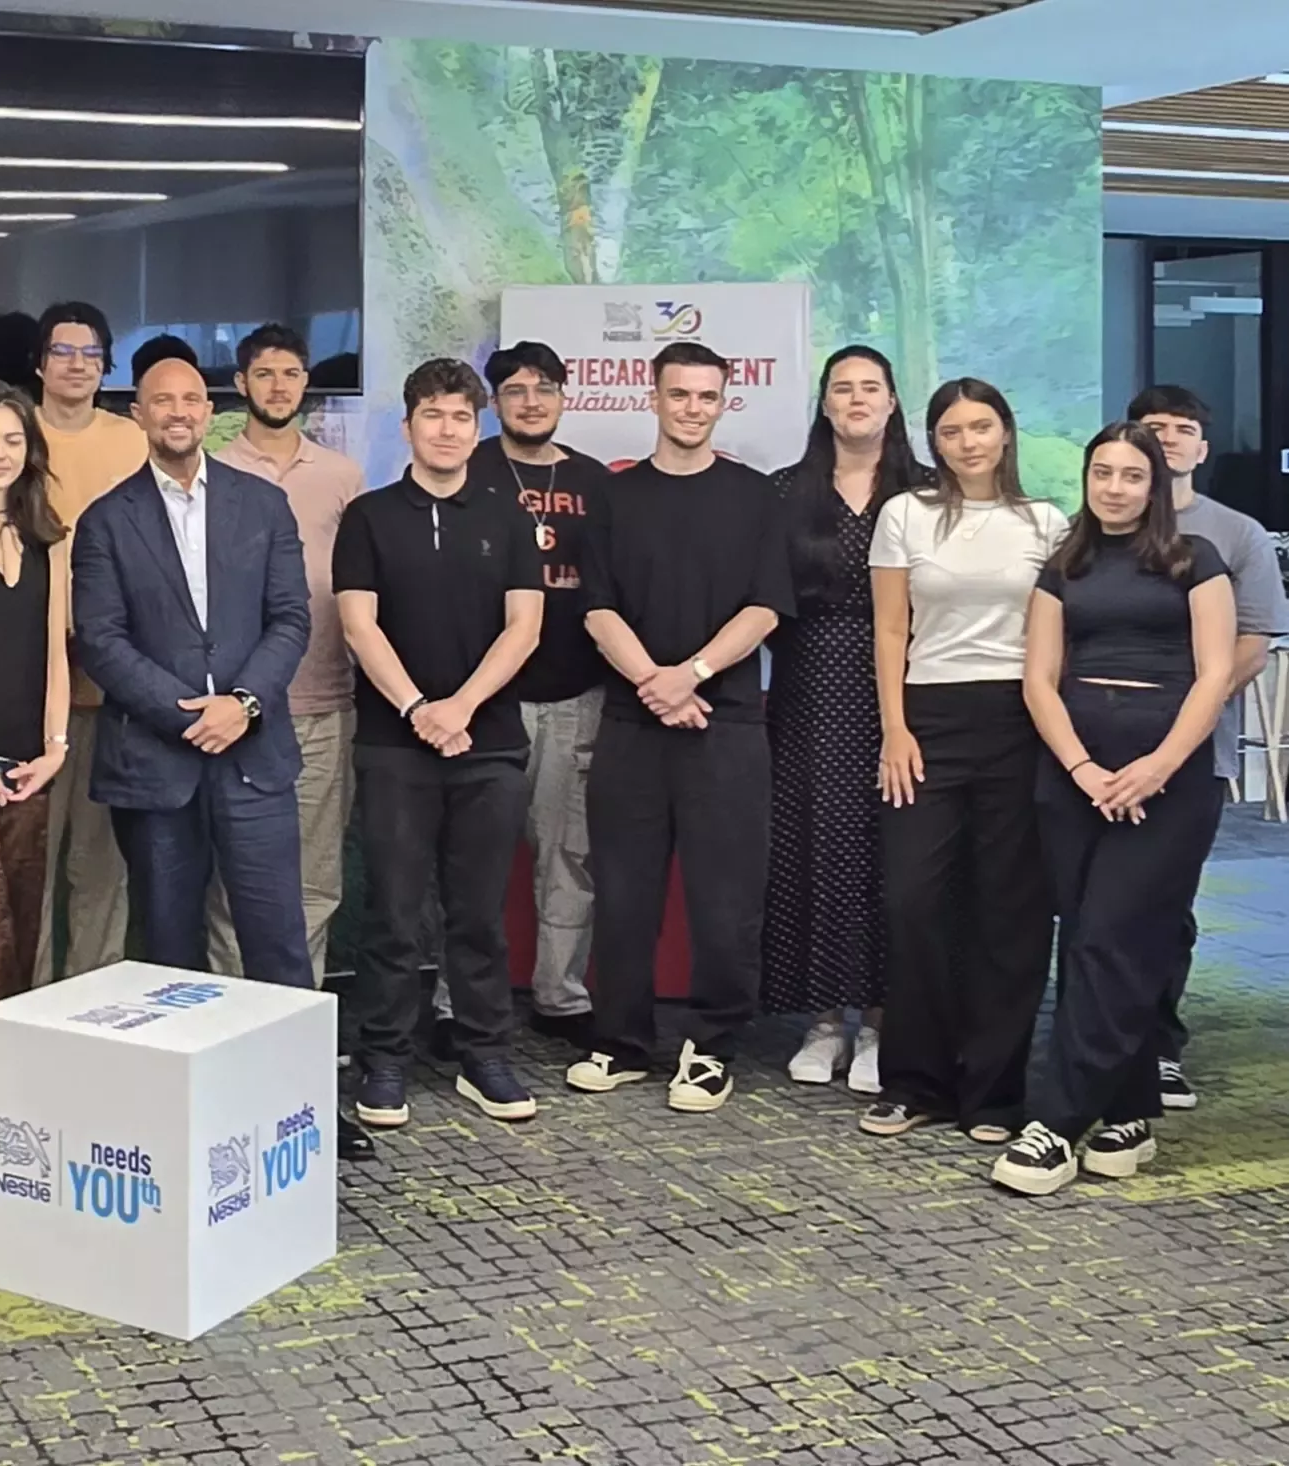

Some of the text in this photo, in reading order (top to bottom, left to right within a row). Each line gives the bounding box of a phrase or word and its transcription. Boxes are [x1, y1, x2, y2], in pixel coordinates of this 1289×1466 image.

[517, 488, 586, 516] GIRL
[276, 1102, 315, 1142] needs
[91, 1142, 152, 1176] needs
